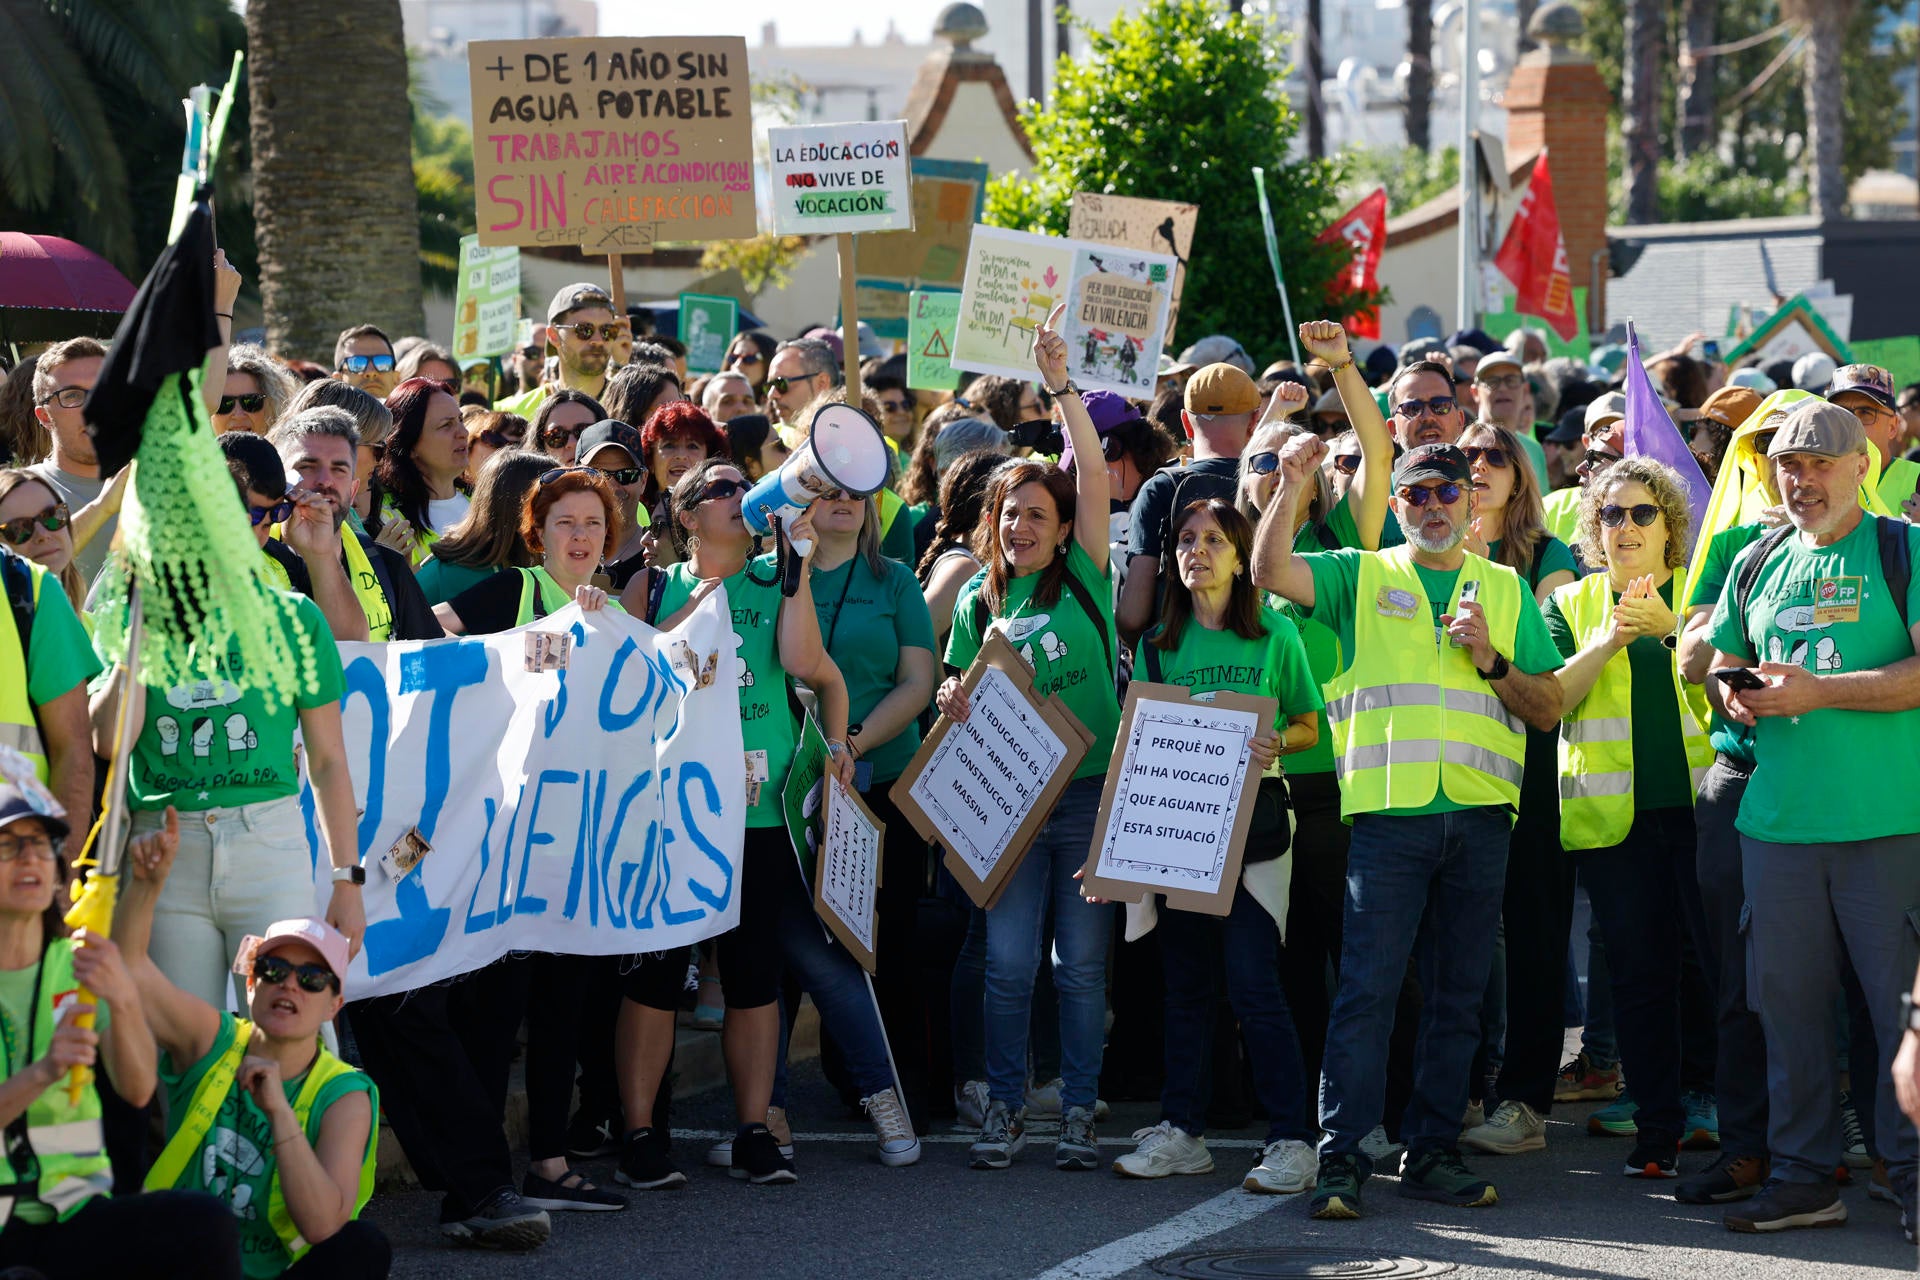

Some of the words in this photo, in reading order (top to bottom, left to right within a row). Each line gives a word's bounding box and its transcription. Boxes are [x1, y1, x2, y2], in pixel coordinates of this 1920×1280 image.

[525, 53, 572, 84] DE
[584, 51, 596, 81] 1
[607, 47, 671, 81] AÑO
[677, 52, 728, 80] SIN
[489, 92, 578, 123] AGUA
[597, 87, 732, 119] POTABLE
[488, 130, 679, 164] TRABAJAMOS
[776, 148, 795, 162] LA
[800, 140, 899, 162] EDUCACIÓN
[584, 164, 637, 186] AIRE
[641, 161, 749, 184] ACONDICION
[791, 173, 816, 188] NO
[819, 171, 856, 187] VIVE
[861, 169, 884, 185] DE
[487, 173, 567, 231] SIN
[584, 195, 733, 224] CALEFACCION
[795, 193, 884, 214] VOCACIÓN
[993, 264, 1008, 279] DIA
[1086, 281, 1102, 294] PER
[989, 310, 1005, 326] DIA
[1082, 303, 1097, 322] EN
[843, 596, 874, 605] ública
[1821, 585, 1836, 596] STOP
[1839, 586, 1856, 598] FP
[1172, 665, 1264, 687] ESTIMEM
[981, 704, 1028, 762] L'EDUCACIÓ
[1027, 760, 1040, 776] ÉS
[1151, 737, 1202, 753] PERQUÈ
[1204, 744, 1225, 756] NO
[966, 722, 984, 748] UNA
[1015, 782, 1029, 799] DE
[955, 747, 1012, 816] CONSTRUCCIÓ
[1133, 764, 1148, 776] HI
[1150, 766, 1168, 778] HA
[1172, 768, 1230, 787] VOCACIÓ
[952, 779, 988, 825] MASSIVA
[1129, 793, 1156, 806] QUE
[1158, 797, 1221, 815] AGUANTE
[1123, 822, 1153, 836] ESTA
[1155, 826, 1216, 844] SITUACIÓ
[388, 844, 400, 858] 75
[848, 850, 857, 911] ESCOLA
[853, 821, 859, 845] EN
